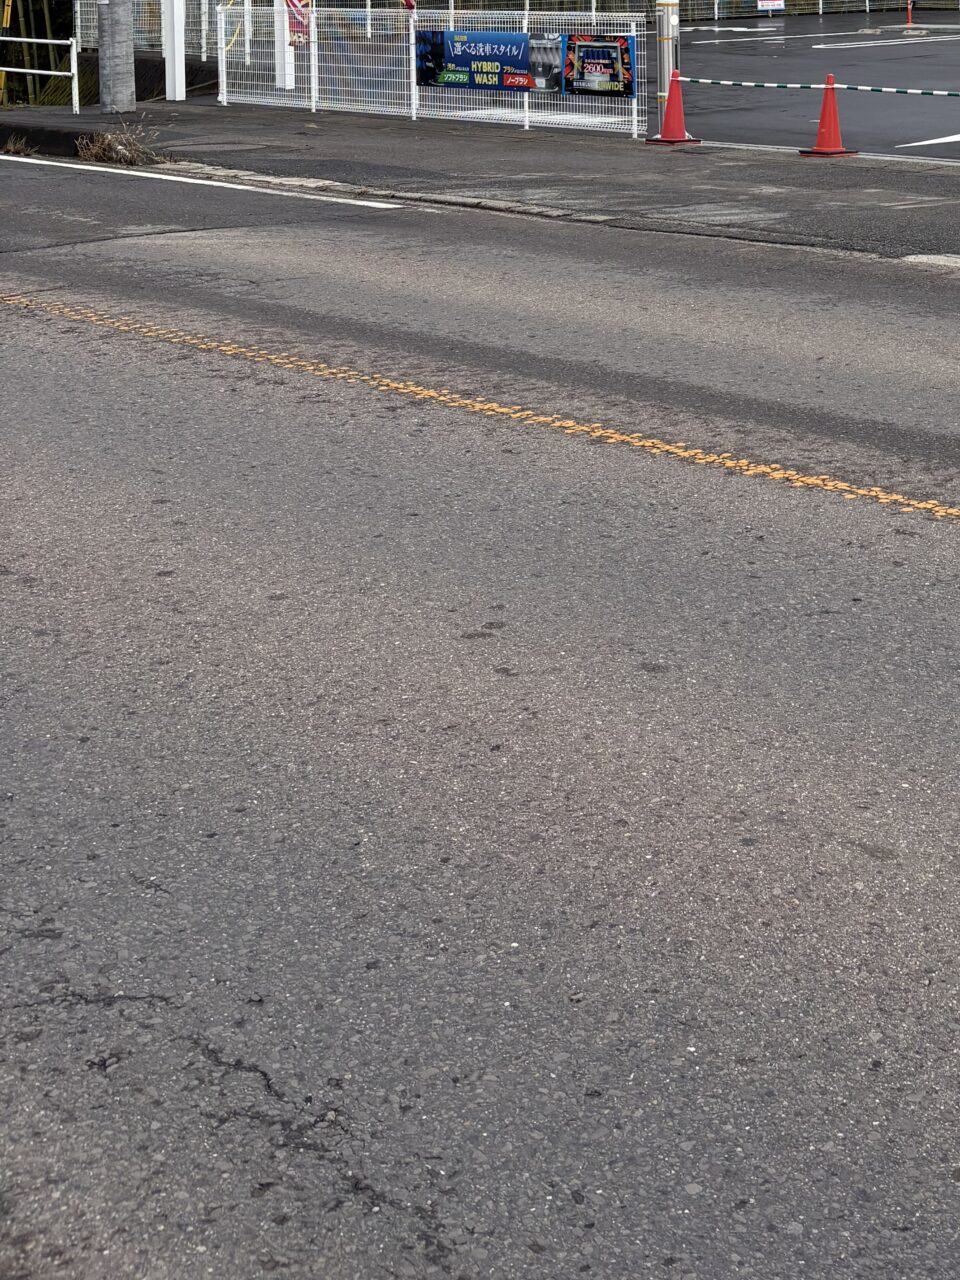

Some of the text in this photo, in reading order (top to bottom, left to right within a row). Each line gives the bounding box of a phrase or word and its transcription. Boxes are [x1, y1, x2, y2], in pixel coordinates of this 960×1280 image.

[453, 41, 519, 56] 選べる洗車スタイル
[471, 60, 501, 73] HYBRID
[474, 73, 499, 85] WASH
